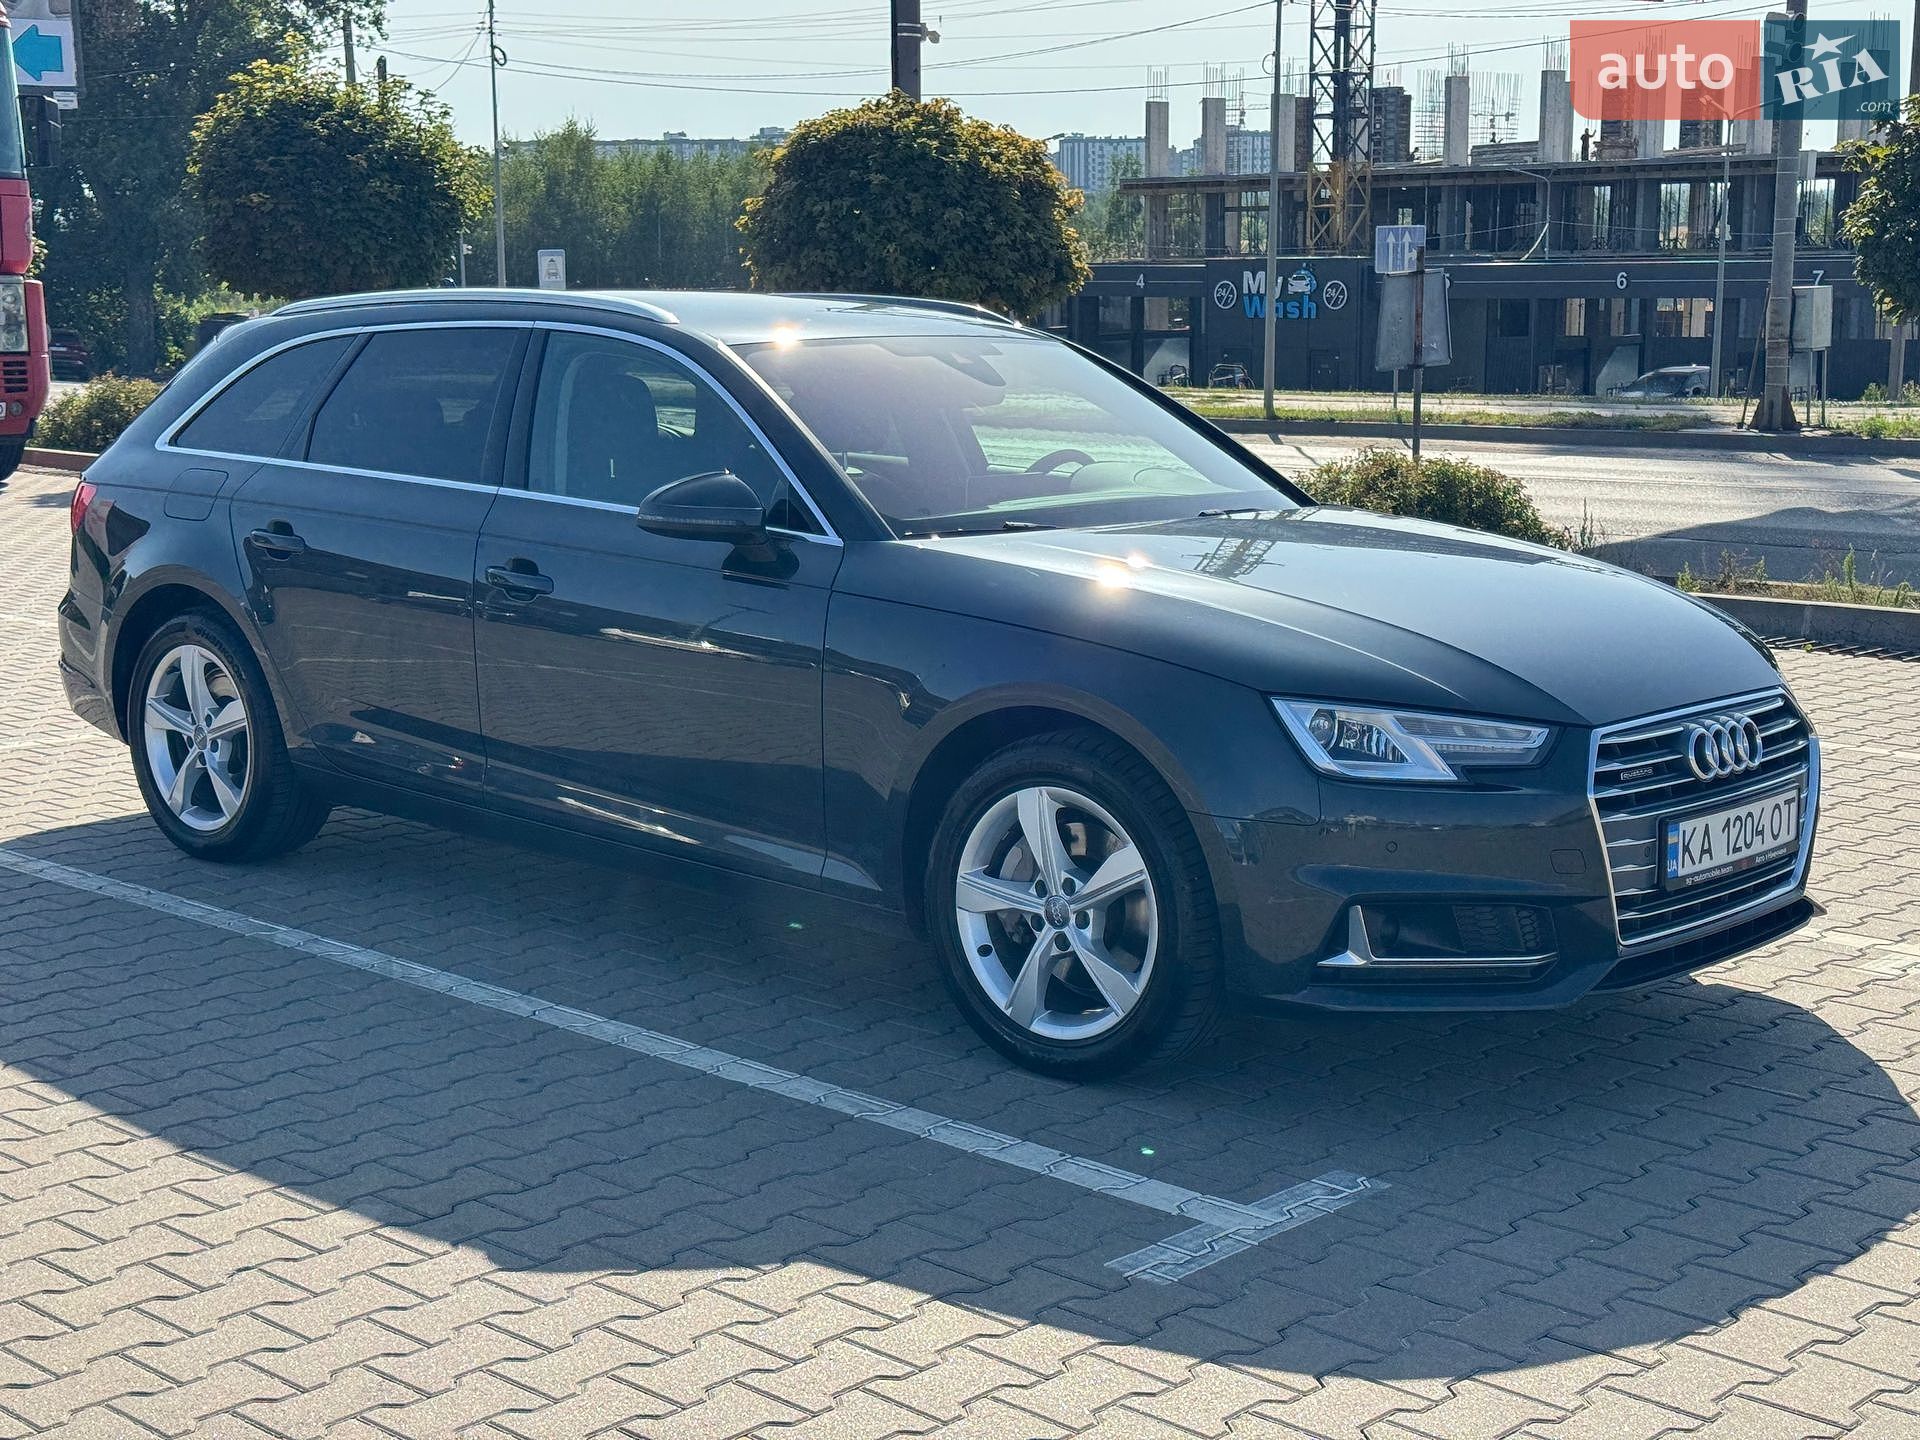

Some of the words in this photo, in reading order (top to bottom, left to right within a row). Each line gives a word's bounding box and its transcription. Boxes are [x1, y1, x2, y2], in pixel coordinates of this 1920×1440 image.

[1136, 273, 1145, 289] 4
[1243, 271, 1283, 299] My
[1616, 271, 1628, 290] 6
[1812, 270, 1824, 286] 7
[1681, 823, 1713, 869] KA
[1721, 807, 1765, 856] 1204
[1770, 796, 1796, 841] OT
[1667, 859, 1678, 872] UA
